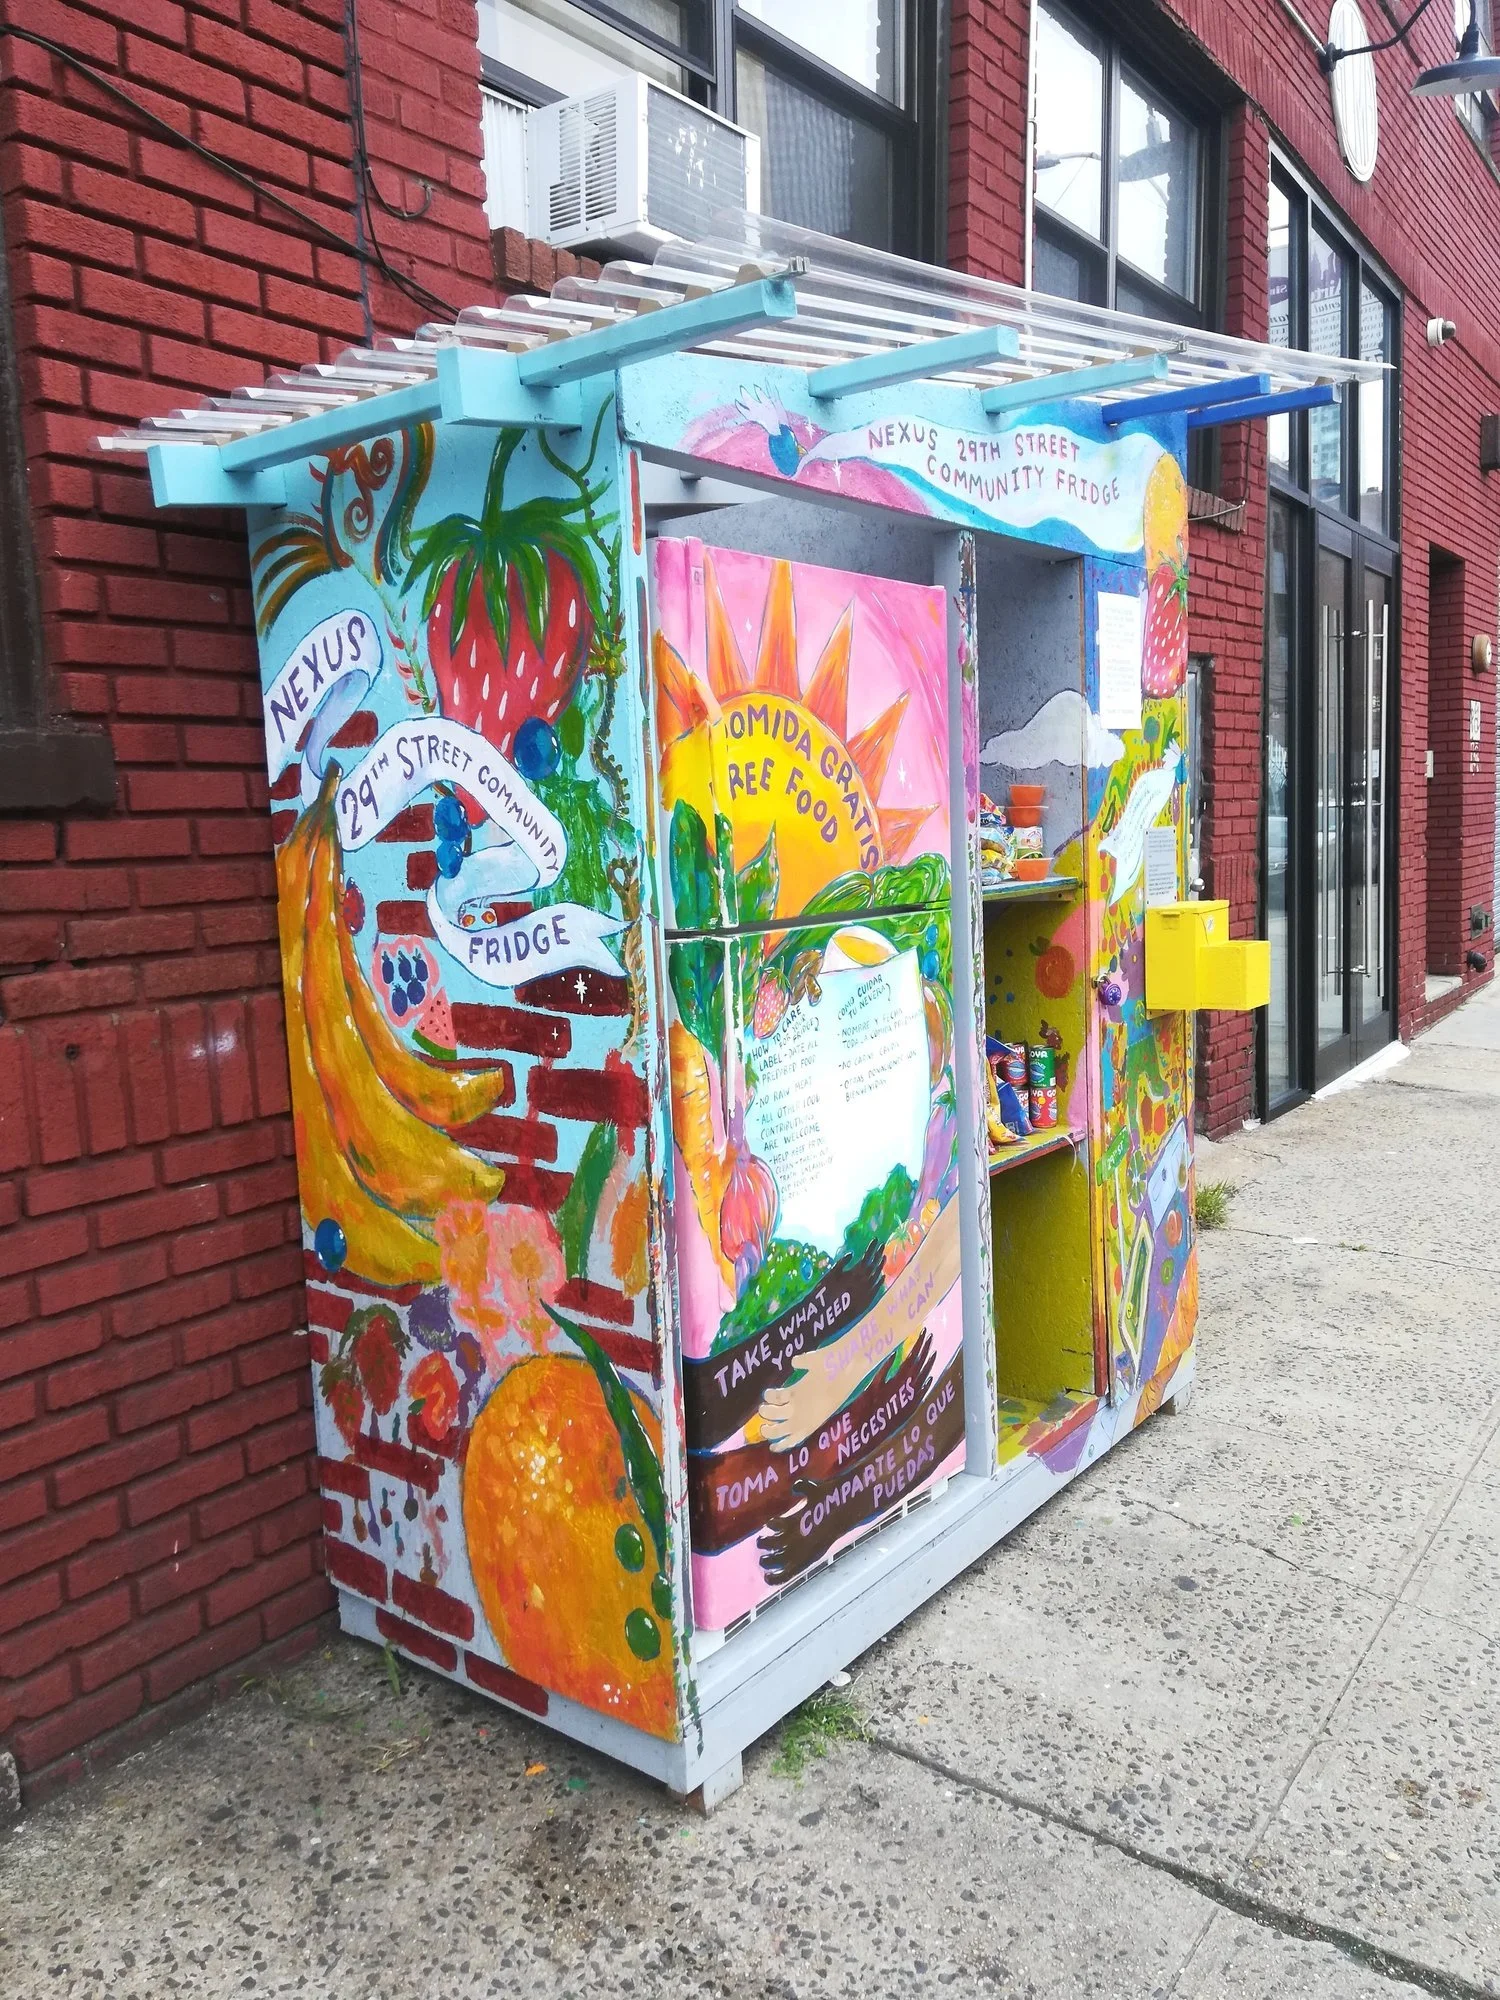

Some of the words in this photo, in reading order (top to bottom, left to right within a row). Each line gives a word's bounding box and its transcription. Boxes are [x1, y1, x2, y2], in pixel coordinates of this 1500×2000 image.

[868, 421, 938, 451] NEXUS
[957, 437, 1001, 463] 29TH
[1014, 432, 1080, 463] STREET
[927, 454, 1045, 502] COMMUNITY
[1056, 467, 1120, 505] FRIDGE
[270, 615, 366, 744] NEXUS
[341, 751, 389, 840] 29TH
[396, 734, 472, 781] STREET
[478, 764, 560, 872] COMMUNITY
[725, 703, 812, 762] OMIDA
[820, 745, 879, 869] GRATIS
[728, 757, 775, 801] REE
[785, 766, 838, 844] FOOD
[469, 913, 570, 965] FRIDGE
[848, 1007, 858, 1019] TU
[860, 984, 886, 1010] NEVERA
[857, 973, 883, 998] CUIDAR
[751, 1042, 769, 1061] HOW
[772, 1032, 781, 1045] TO
[781, 1004, 802, 1033] CARE
[759, 1053, 783, 1072] LABEL
[1031, 1050, 1048, 1059] OYA
[773, 1087, 791, 1102] RAW
[764, 1138, 779, 1152] ARE
[783, 1122, 821, 1144] WELCOME
[713, 1333, 773, 1398] TAKE
[779, 1287, 827, 1341] WHAT
[772, 1336, 804, 1371] YOU
[813, 1291, 851, 1337] NEED
[823, 1316, 880, 1384] SHARE
[887, 1262, 925, 1314] WHAT
[864, 1331, 895, 1366] YOU
[907, 1272, 934, 1320] CAN
[799, 1449, 897, 1537] COMPARTE
[902, 1424, 921, 1455] LO
[925, 1380, 956, 1425] QUE
[837, 1376, 916, 1465] NECESITES
[715, 1466, 779, 1512] TOMA
[788, 1448, 809, 1475] LO
[818, 1411, 853, 1449] QUE
[873, 1434, 936, 1510] PUEDAS
